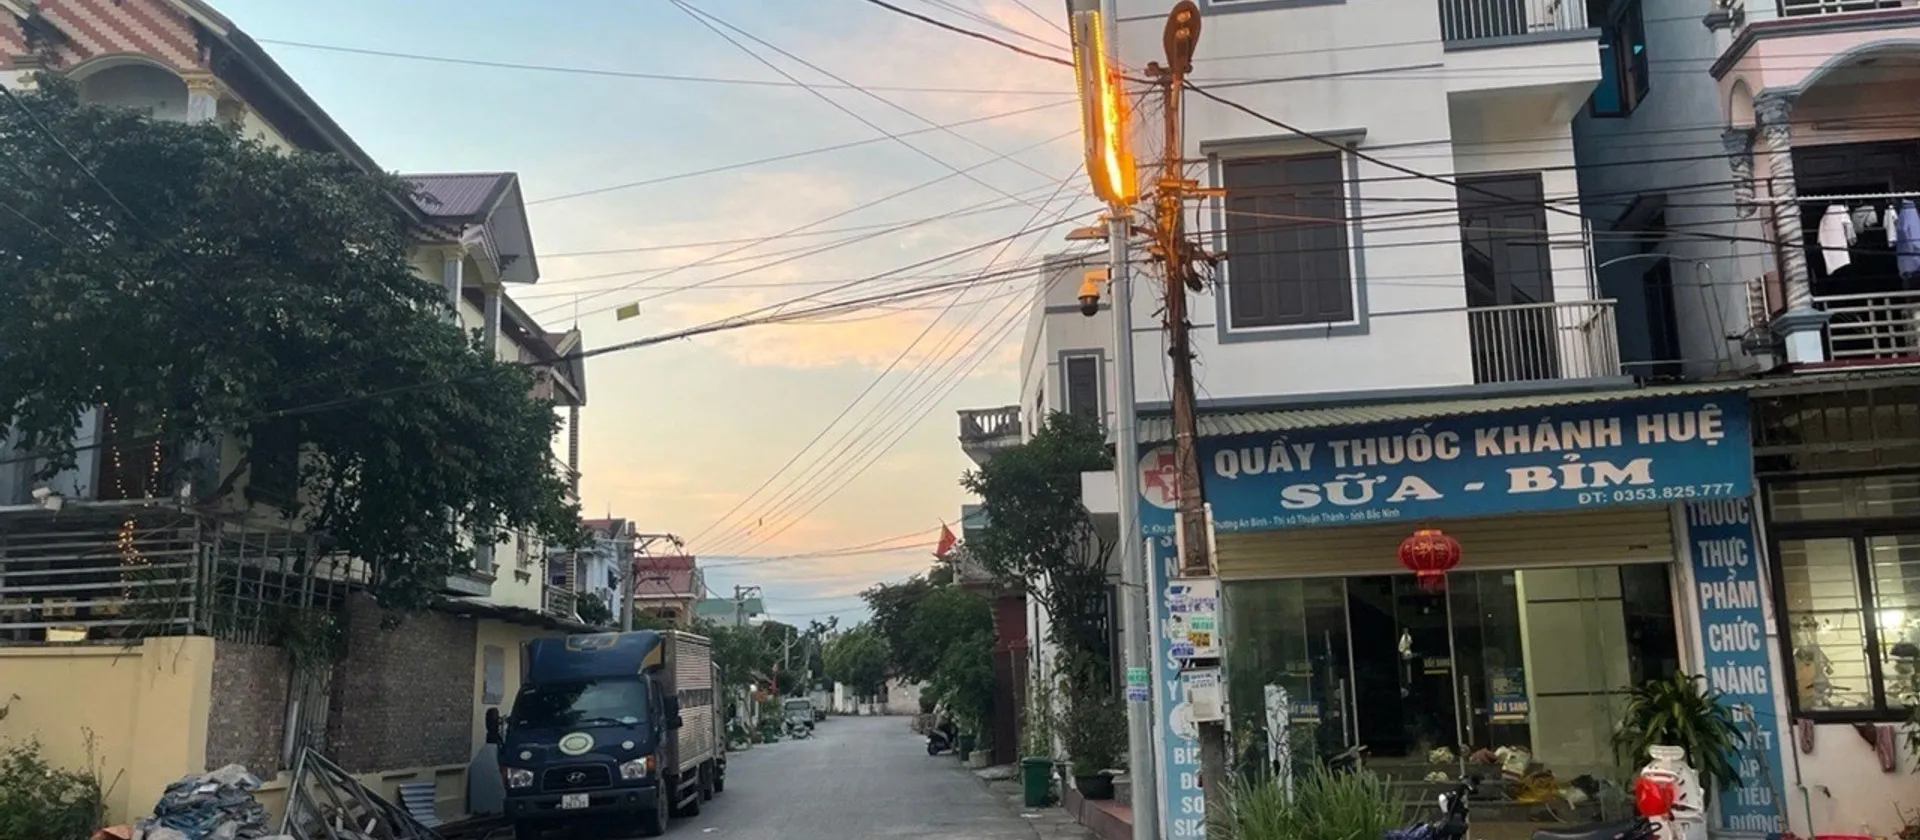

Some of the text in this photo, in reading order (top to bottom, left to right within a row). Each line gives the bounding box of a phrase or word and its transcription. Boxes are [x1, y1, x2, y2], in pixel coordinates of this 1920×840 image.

[1214, 402, 1725, 480] QUẦY THUỐC KHÁNH HUỆ
[1280, 453, 1655, 510] SỮA - BỈM
[1577, 482, 1735, 505] ĐT: 0353.825.777
[1699, 567, 1759, 610] PHẨM
[1708, 614, 1761, 653] CHỨC
[1711, 660, 1769, 695] NĂNG
